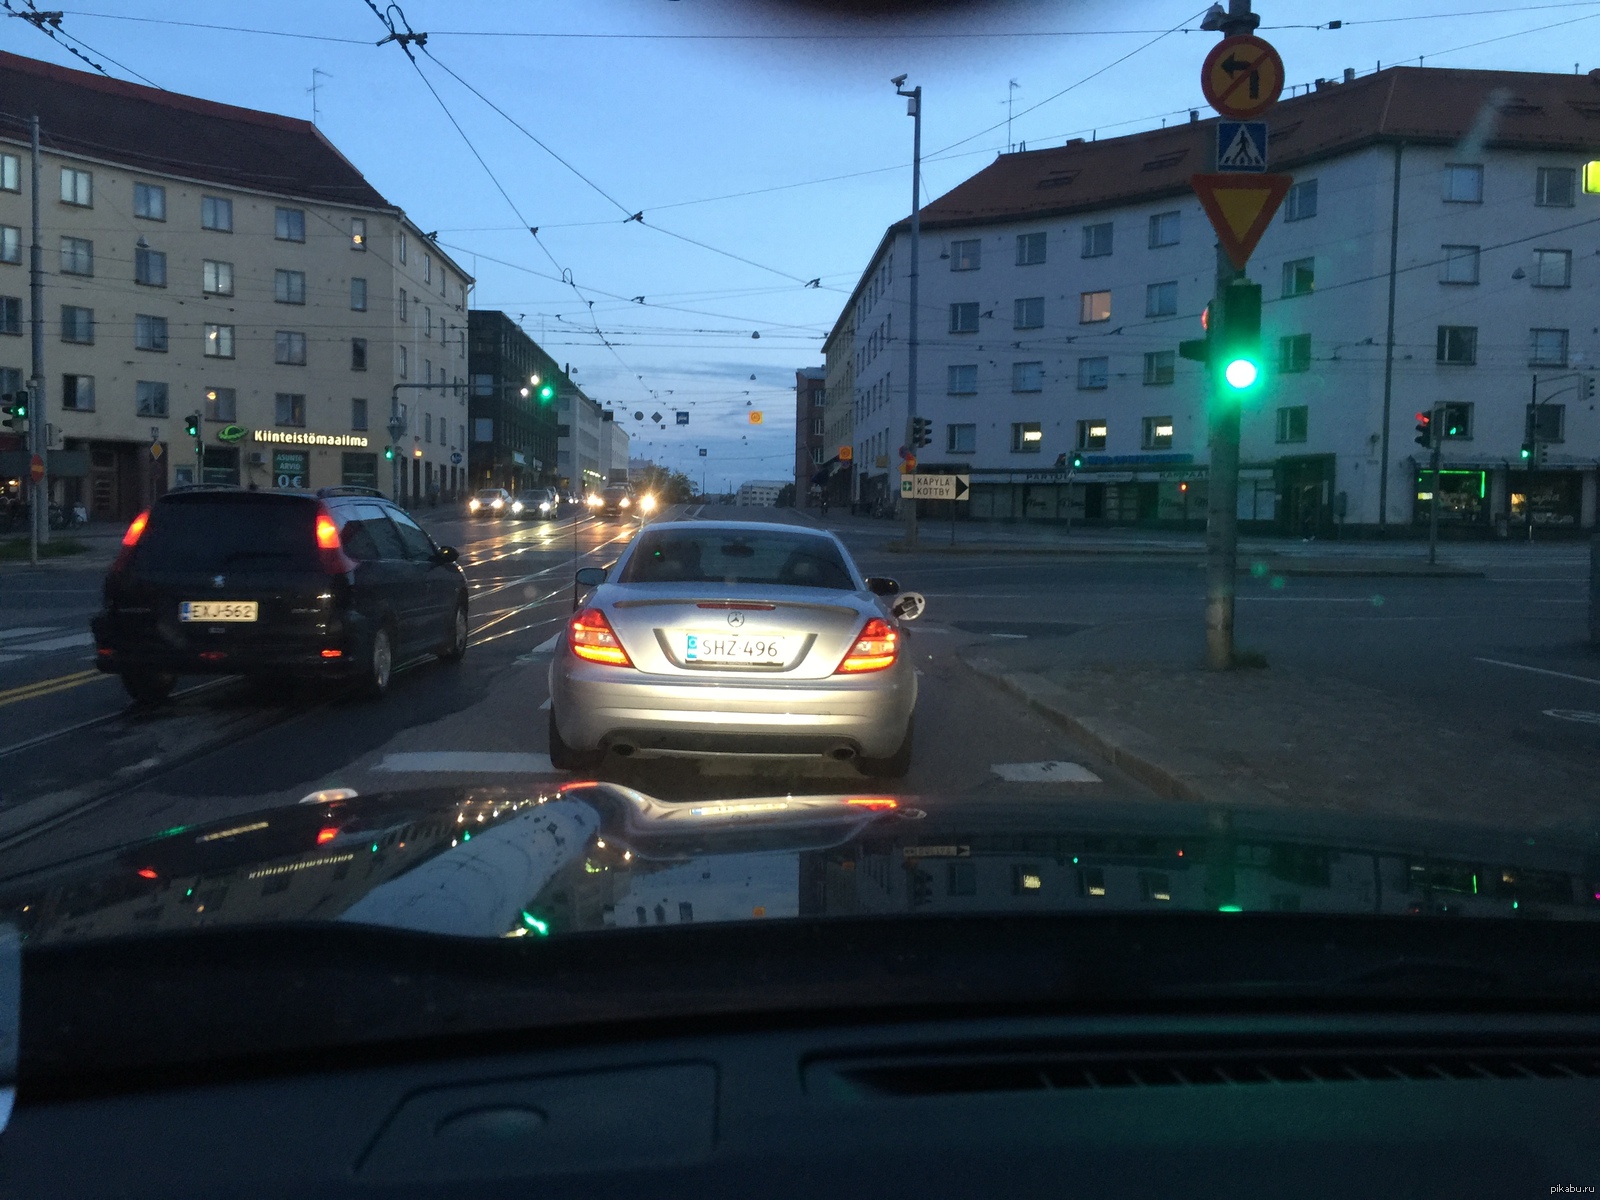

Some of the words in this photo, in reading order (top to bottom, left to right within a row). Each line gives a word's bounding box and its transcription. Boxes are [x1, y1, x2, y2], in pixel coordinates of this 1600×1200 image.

[254, 430, 368, 447] Kiinteistömaailma
[916, 487, 950, 496] KOTTBY
[702, 639, 778, 658] SHZ-496
